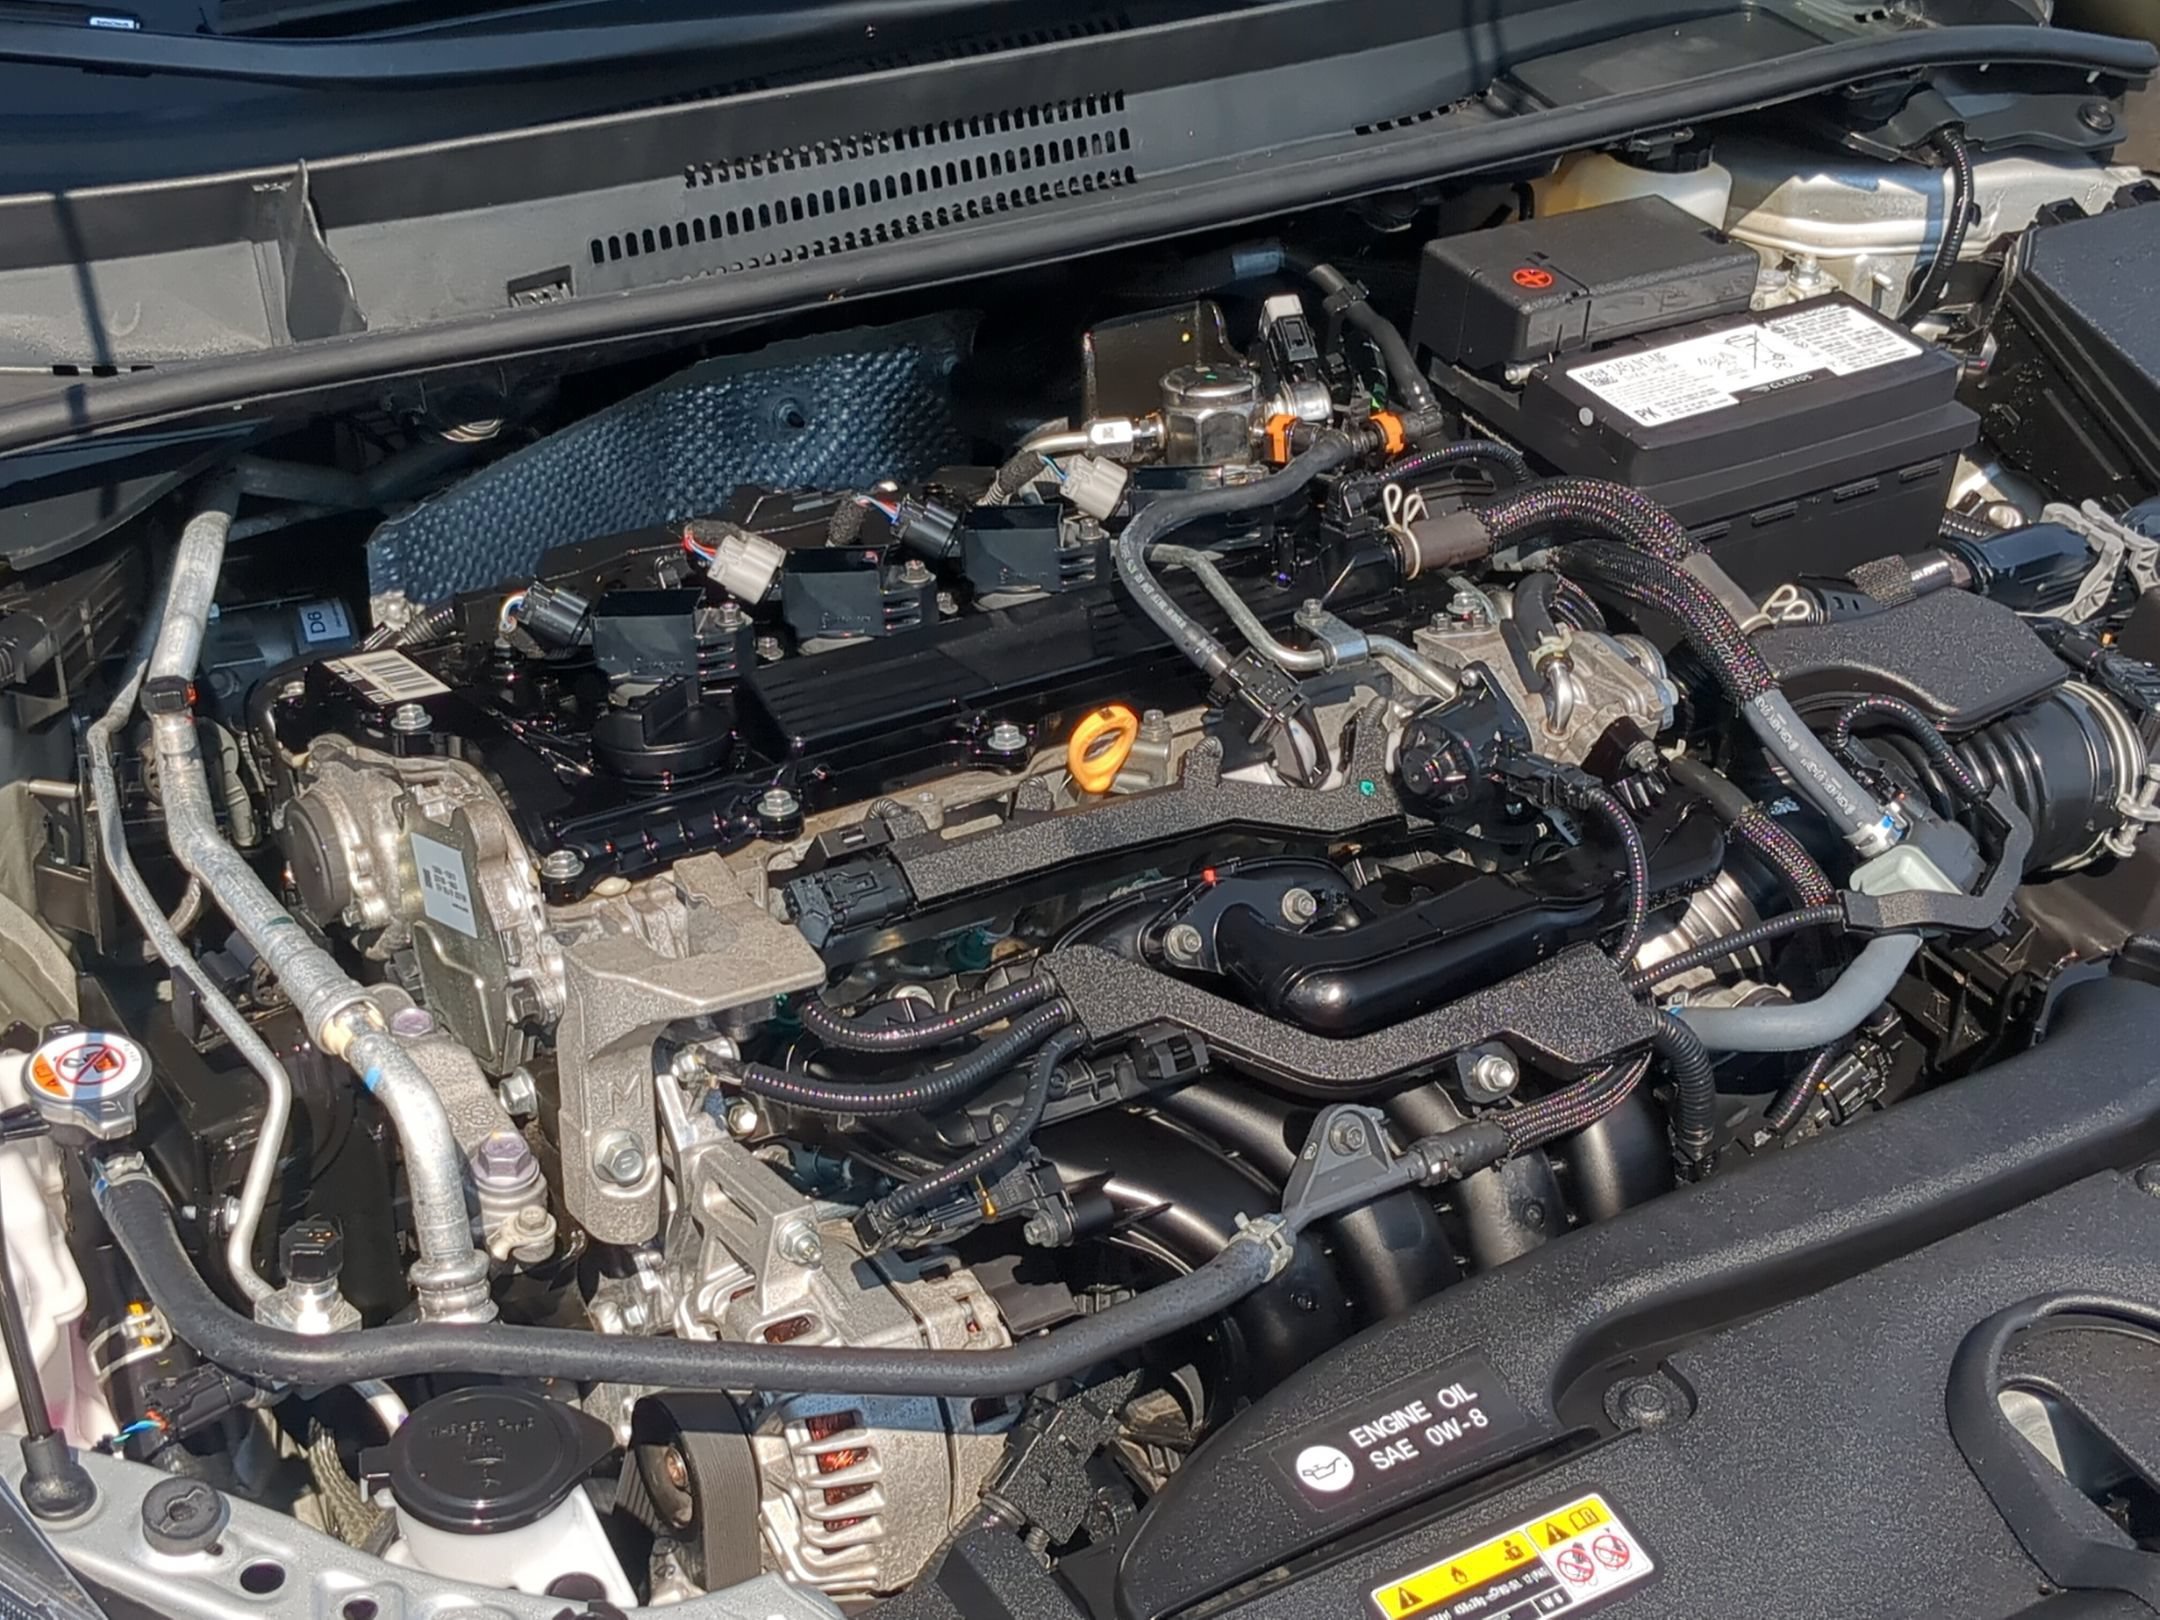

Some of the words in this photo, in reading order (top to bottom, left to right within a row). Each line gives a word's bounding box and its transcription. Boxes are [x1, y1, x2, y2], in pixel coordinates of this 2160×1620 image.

[307, 611, 327, 634] D6
[1349, 1400, 1432, 1448] ENGINE
[1437, 1382, 1478, 1409] OIL
[1369, 1438, 1419, 1470] SAE
[1425, 1408, 1489, 1446] 0W-8
